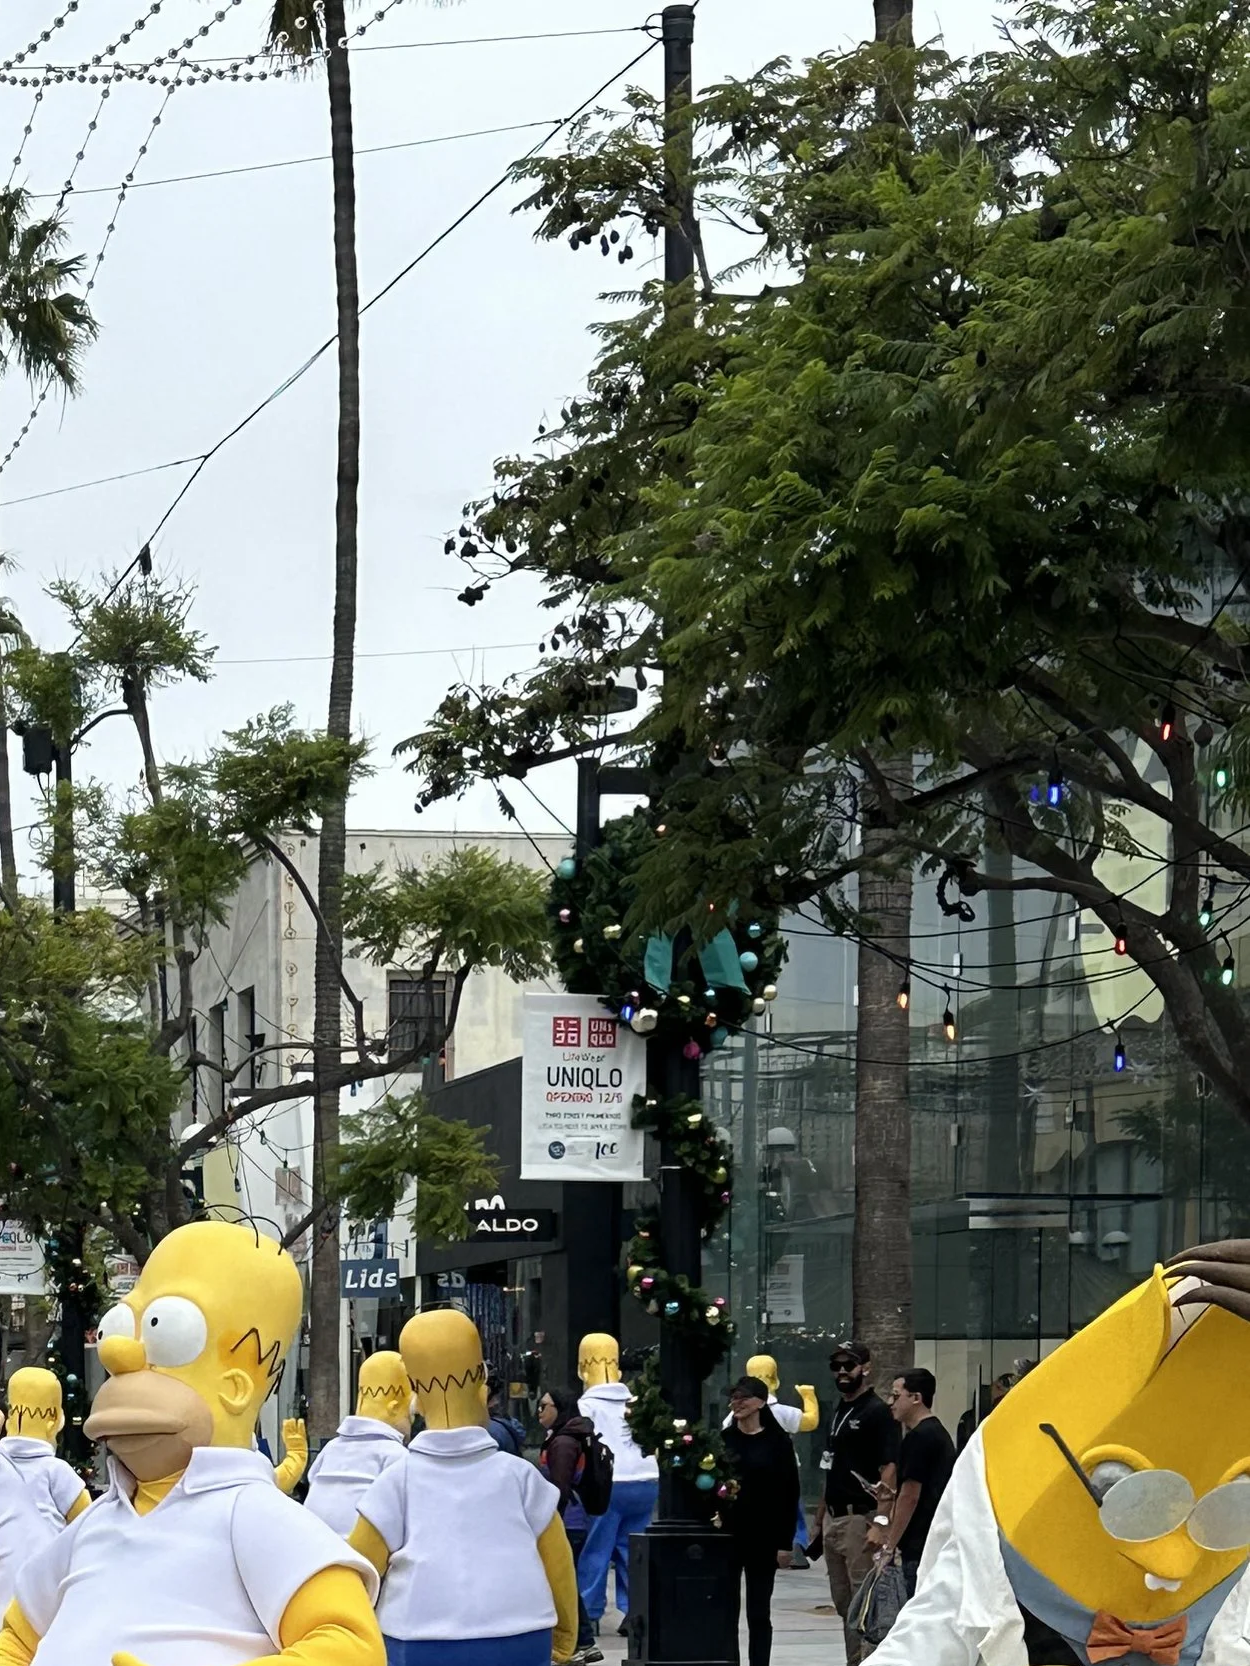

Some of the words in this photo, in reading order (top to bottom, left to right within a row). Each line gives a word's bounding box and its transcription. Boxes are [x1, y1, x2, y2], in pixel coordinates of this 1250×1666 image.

[591, 1020, 612, 1032] UNI
[590, 1033, 614, 1046] QLO
[547, 1066, 622, 1090] UNIQLO
[546, 1092, 593, 1103] OPENING
[476, 1218, 539, 1232] ALDO
[345, 1268, 397, 1289] Lids
